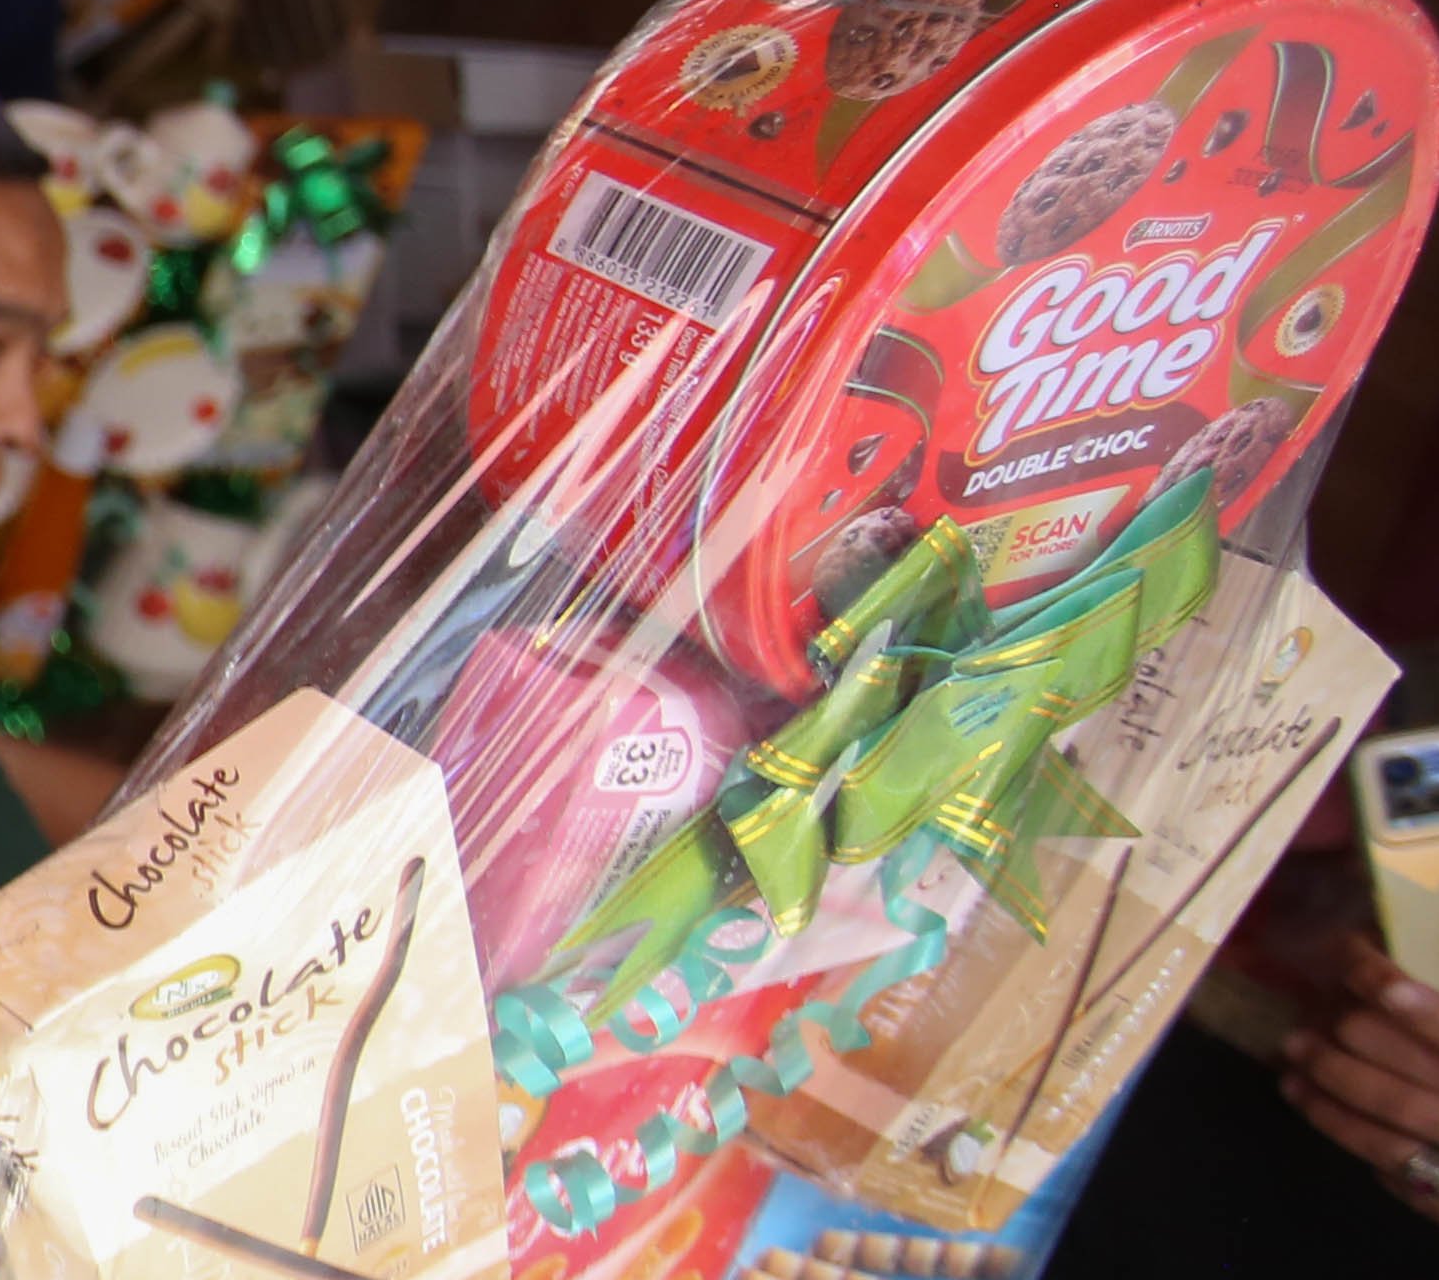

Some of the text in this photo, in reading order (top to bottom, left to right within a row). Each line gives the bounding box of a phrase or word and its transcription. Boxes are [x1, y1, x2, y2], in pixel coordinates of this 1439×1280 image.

[631, 310, 664, 348] 133
[974, 223, 1285, 375] Good
[973, 325, 1219, 455] Time
[962, 425, 1156, 498] DOUBLE CHOC
[1005, 546, 1033, 566] FOR
[1011, 511, 1092, 551] SCAN
[617, 741, 656, 787] 33
[87, 763, 240, 933] Chocolate
[86, 906, 384, 1132] Chocolate
